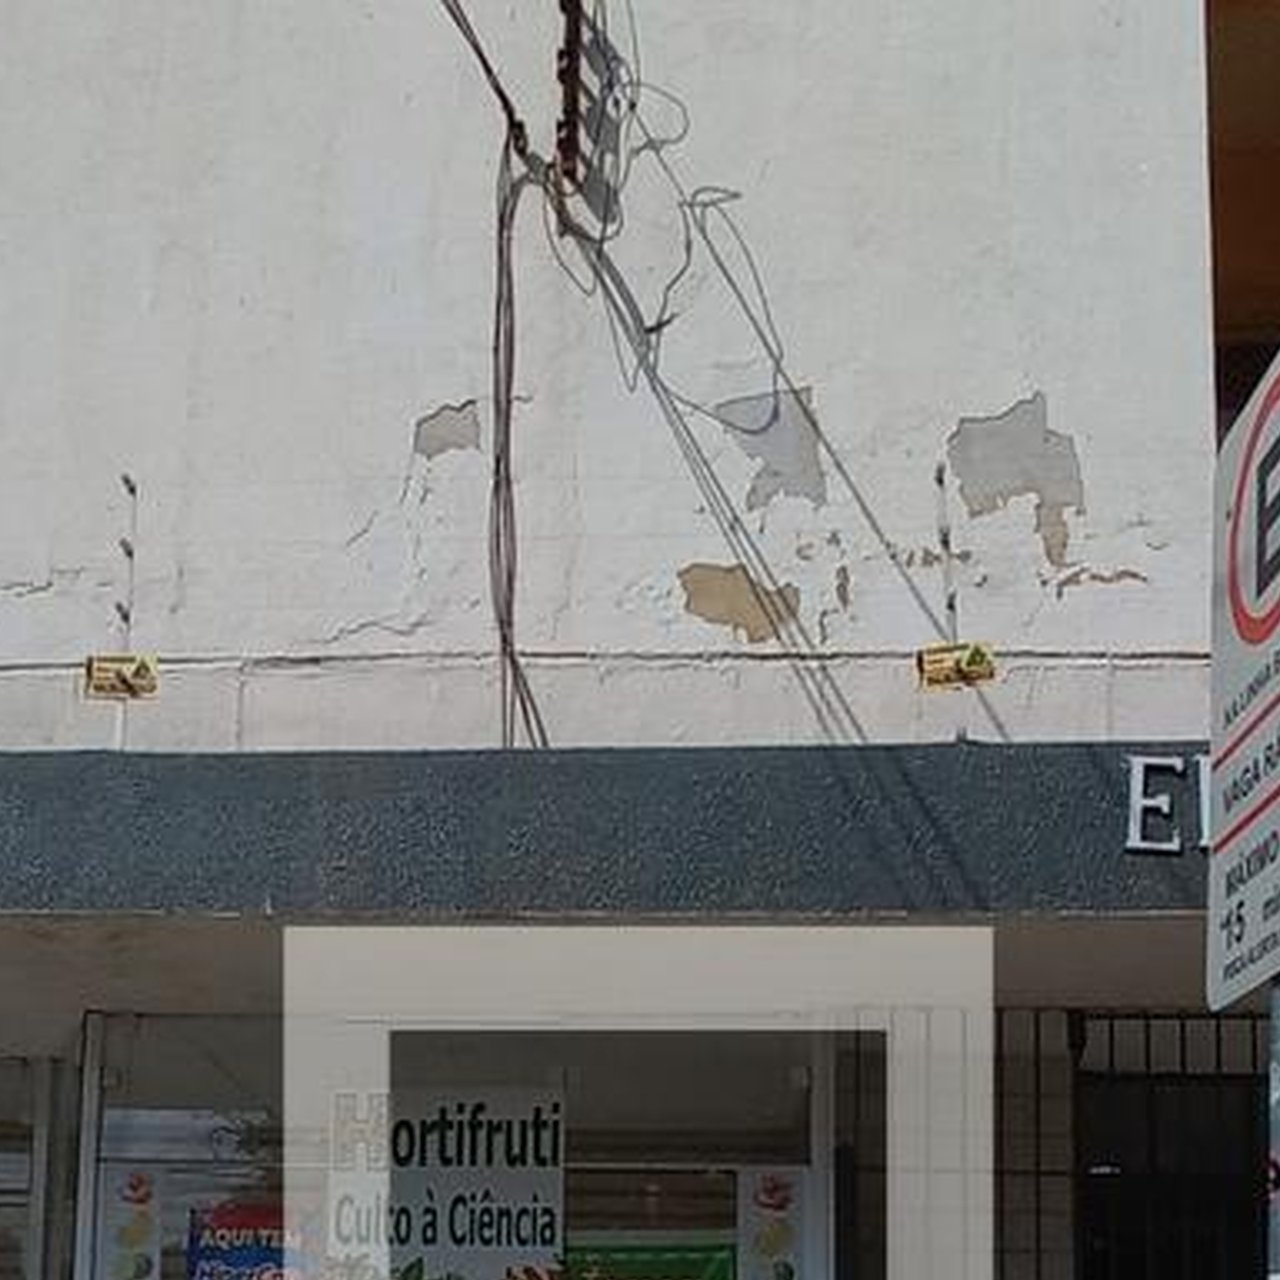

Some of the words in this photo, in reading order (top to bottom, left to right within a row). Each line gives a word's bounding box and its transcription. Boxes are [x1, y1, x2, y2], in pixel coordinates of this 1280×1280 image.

[1222, 757, 1261, 814] VAGA
[1220, 899, 1246, 951] 15
[334, 1093, 561, 1172] Hortifruti
[421, 1187, 438, 1246] à
[448, 1187, 556, 1247] Ciência
